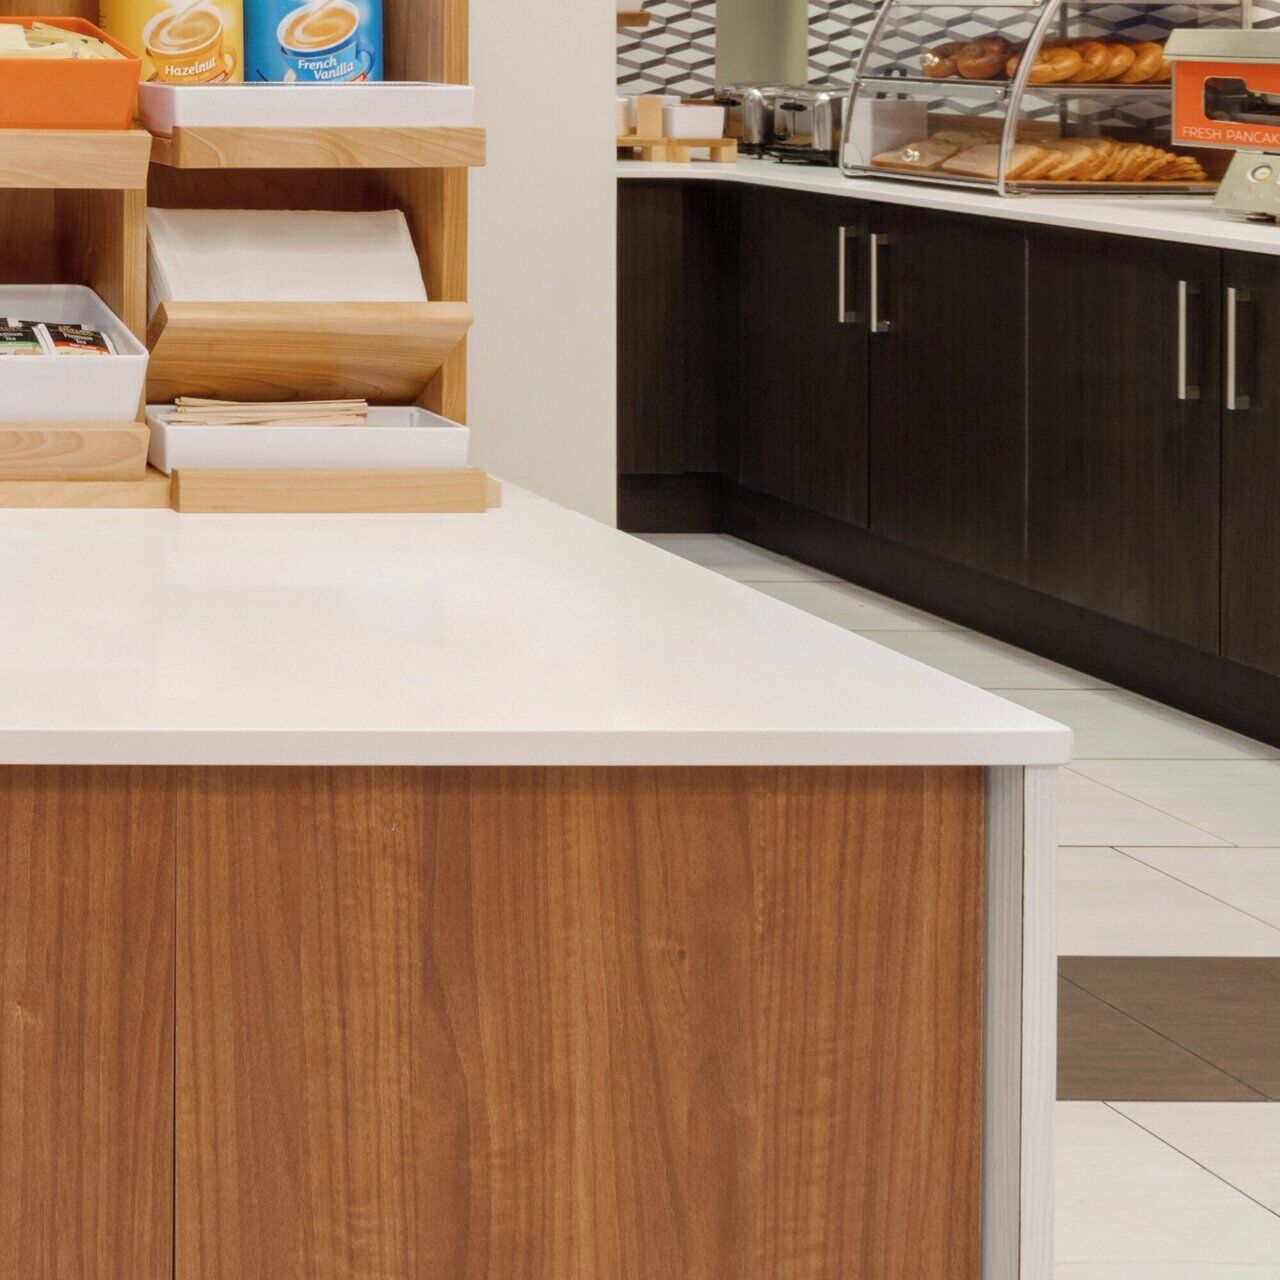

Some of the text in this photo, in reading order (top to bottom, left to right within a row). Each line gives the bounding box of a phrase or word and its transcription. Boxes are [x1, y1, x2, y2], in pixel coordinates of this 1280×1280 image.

[164, 56, 216, 76] Hazelnut
[297, 56, 338, 71] French
[312, 61, 354, 80] Vanilla
[1181, 126, 1223, 139] FRESH
